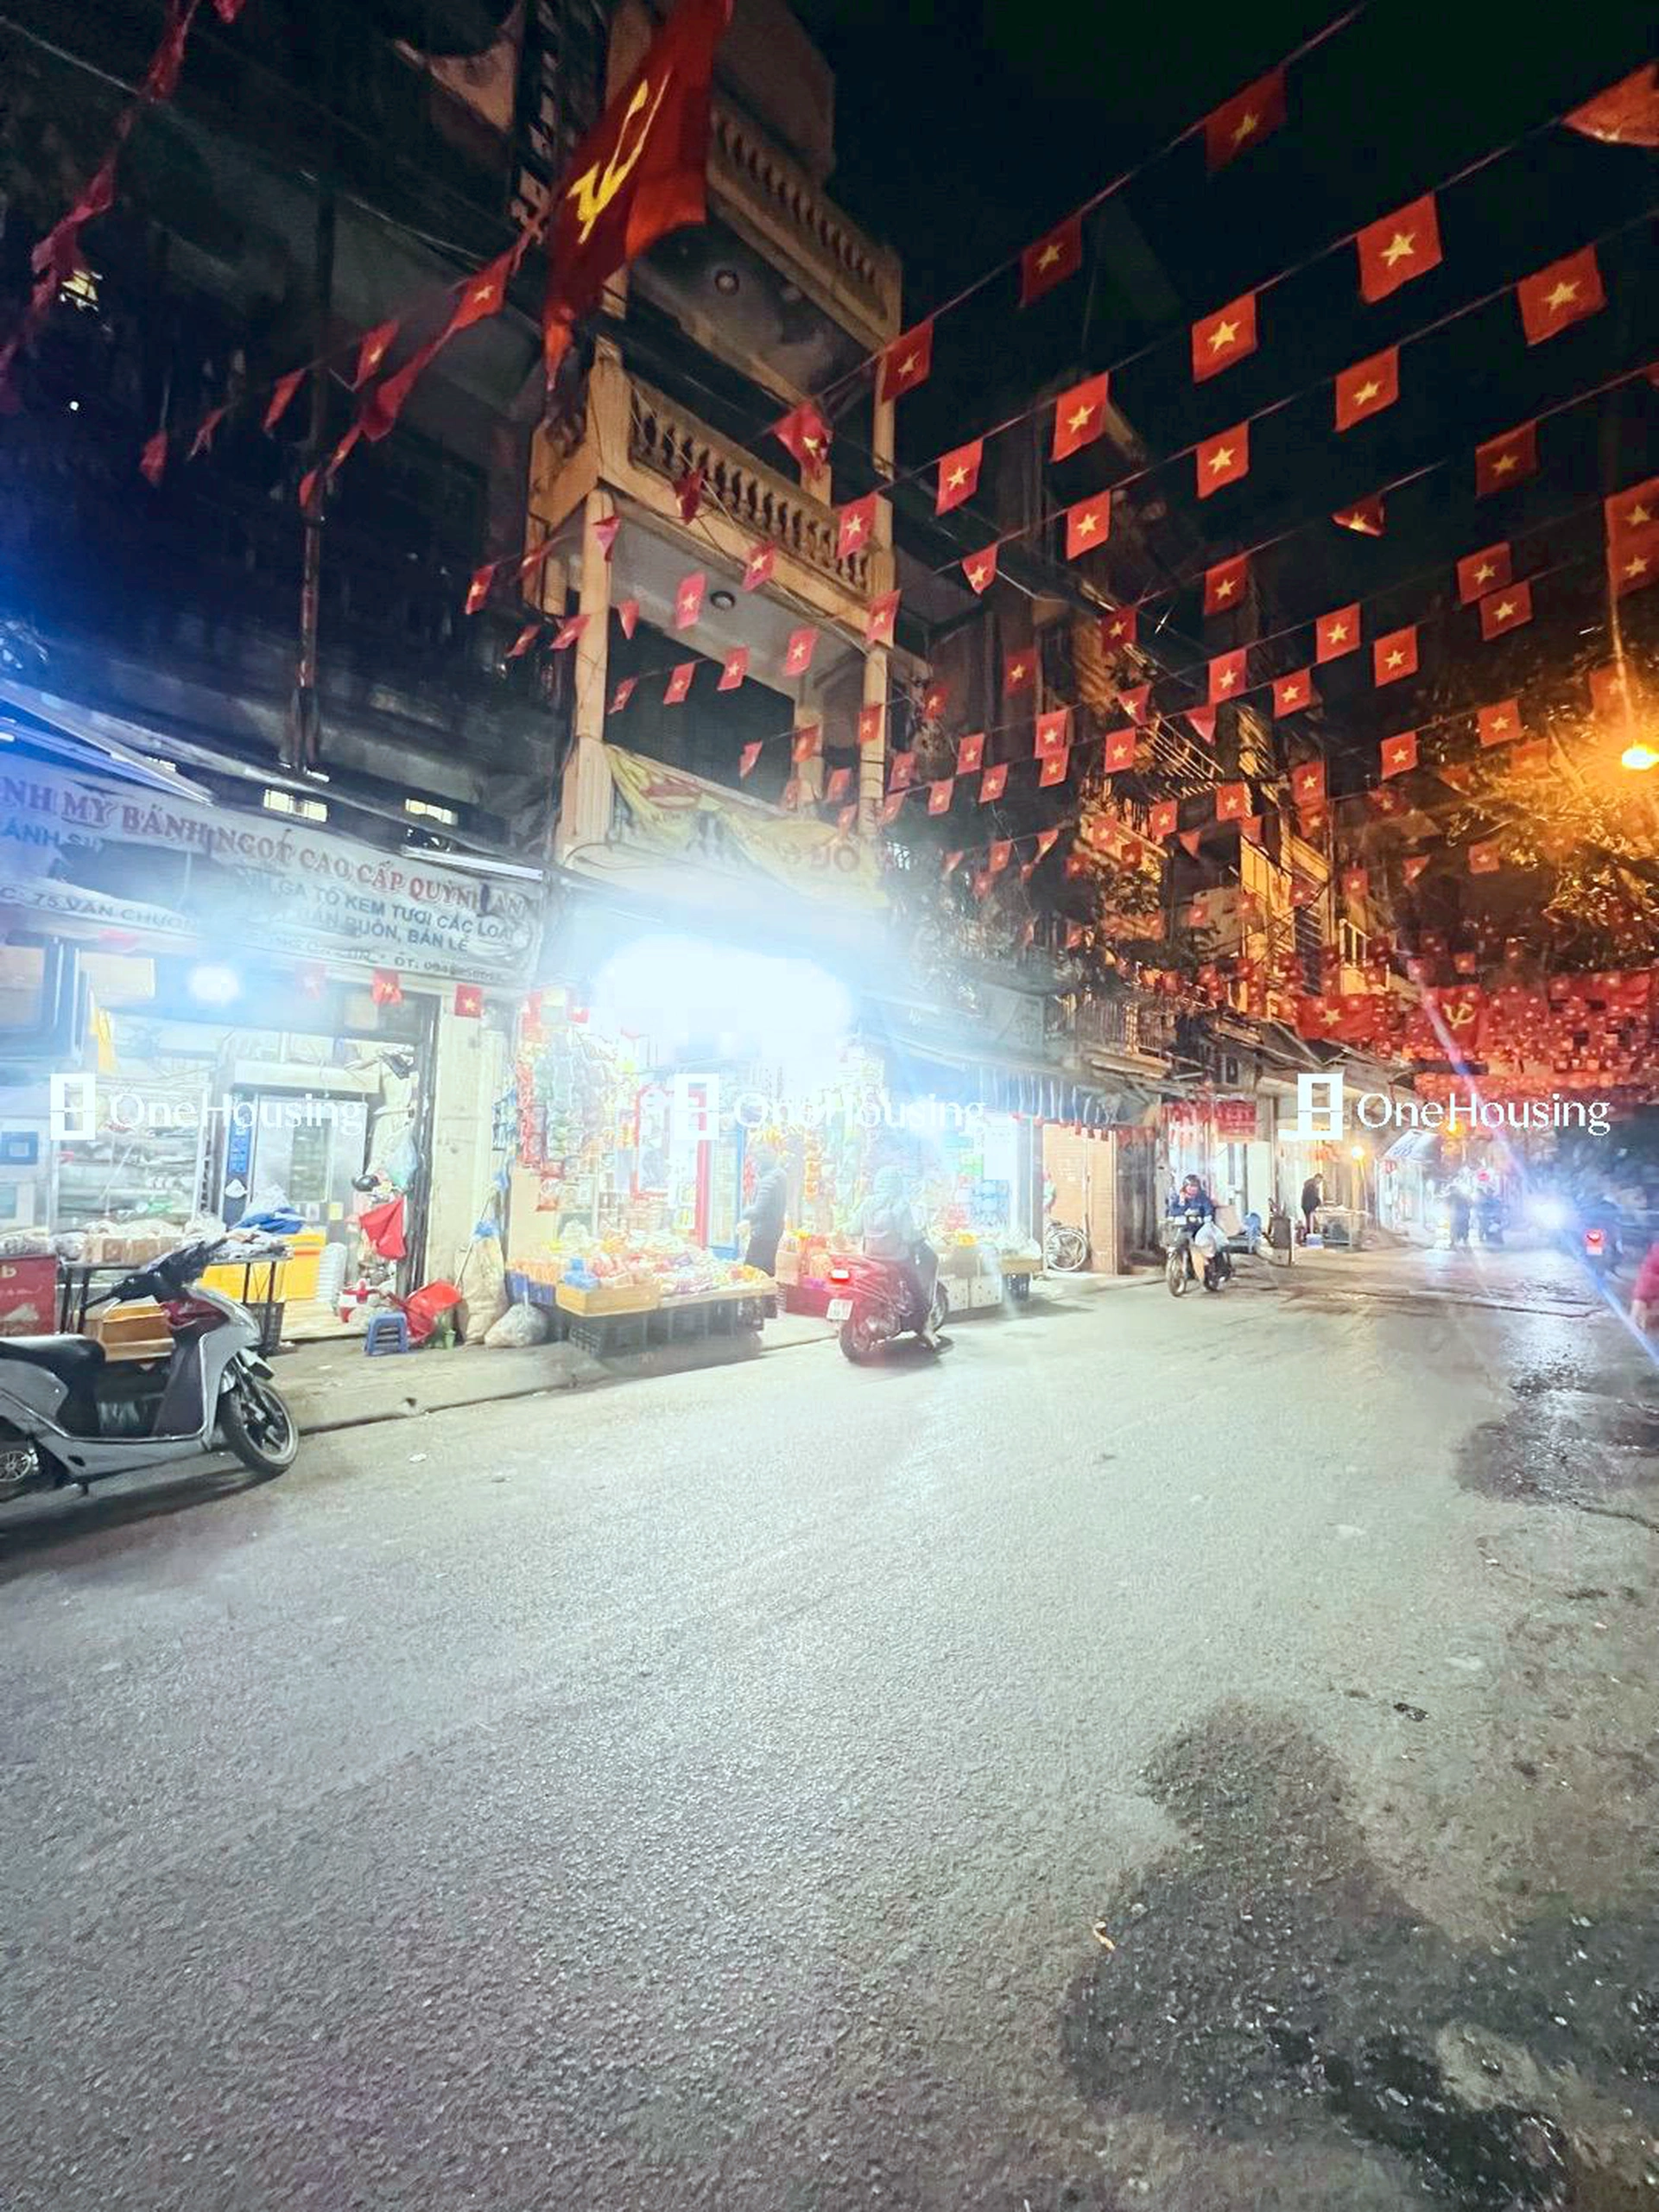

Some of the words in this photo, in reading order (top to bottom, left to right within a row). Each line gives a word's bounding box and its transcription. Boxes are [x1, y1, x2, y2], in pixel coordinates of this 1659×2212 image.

[299, 848, 350, 878] CAO
[345, 894, 385, 917] KEM
[435, 910, 472, 935] CÁC
[407, 926, 444, 949] BÁN
